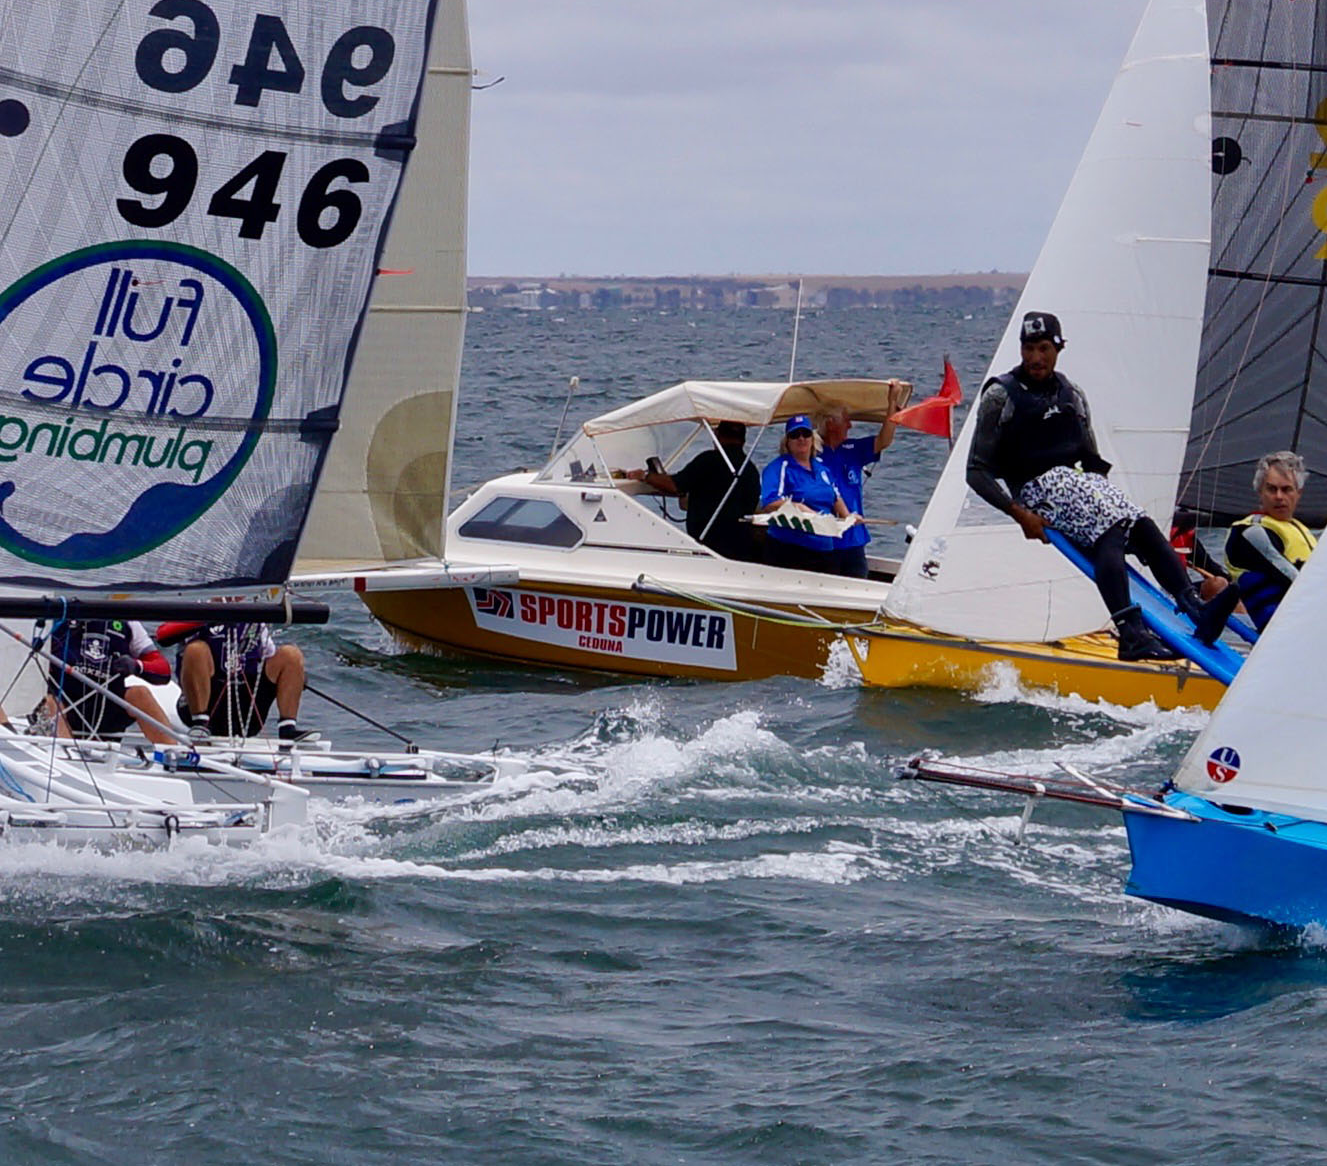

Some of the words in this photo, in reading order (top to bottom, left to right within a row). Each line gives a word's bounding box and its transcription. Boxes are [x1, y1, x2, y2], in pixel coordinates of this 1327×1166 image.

[115, 133, 371, 249] 946
[520, 592, 727, 650] SPORTSPOWER
[578, 635, 624, 654] CEDUNA
